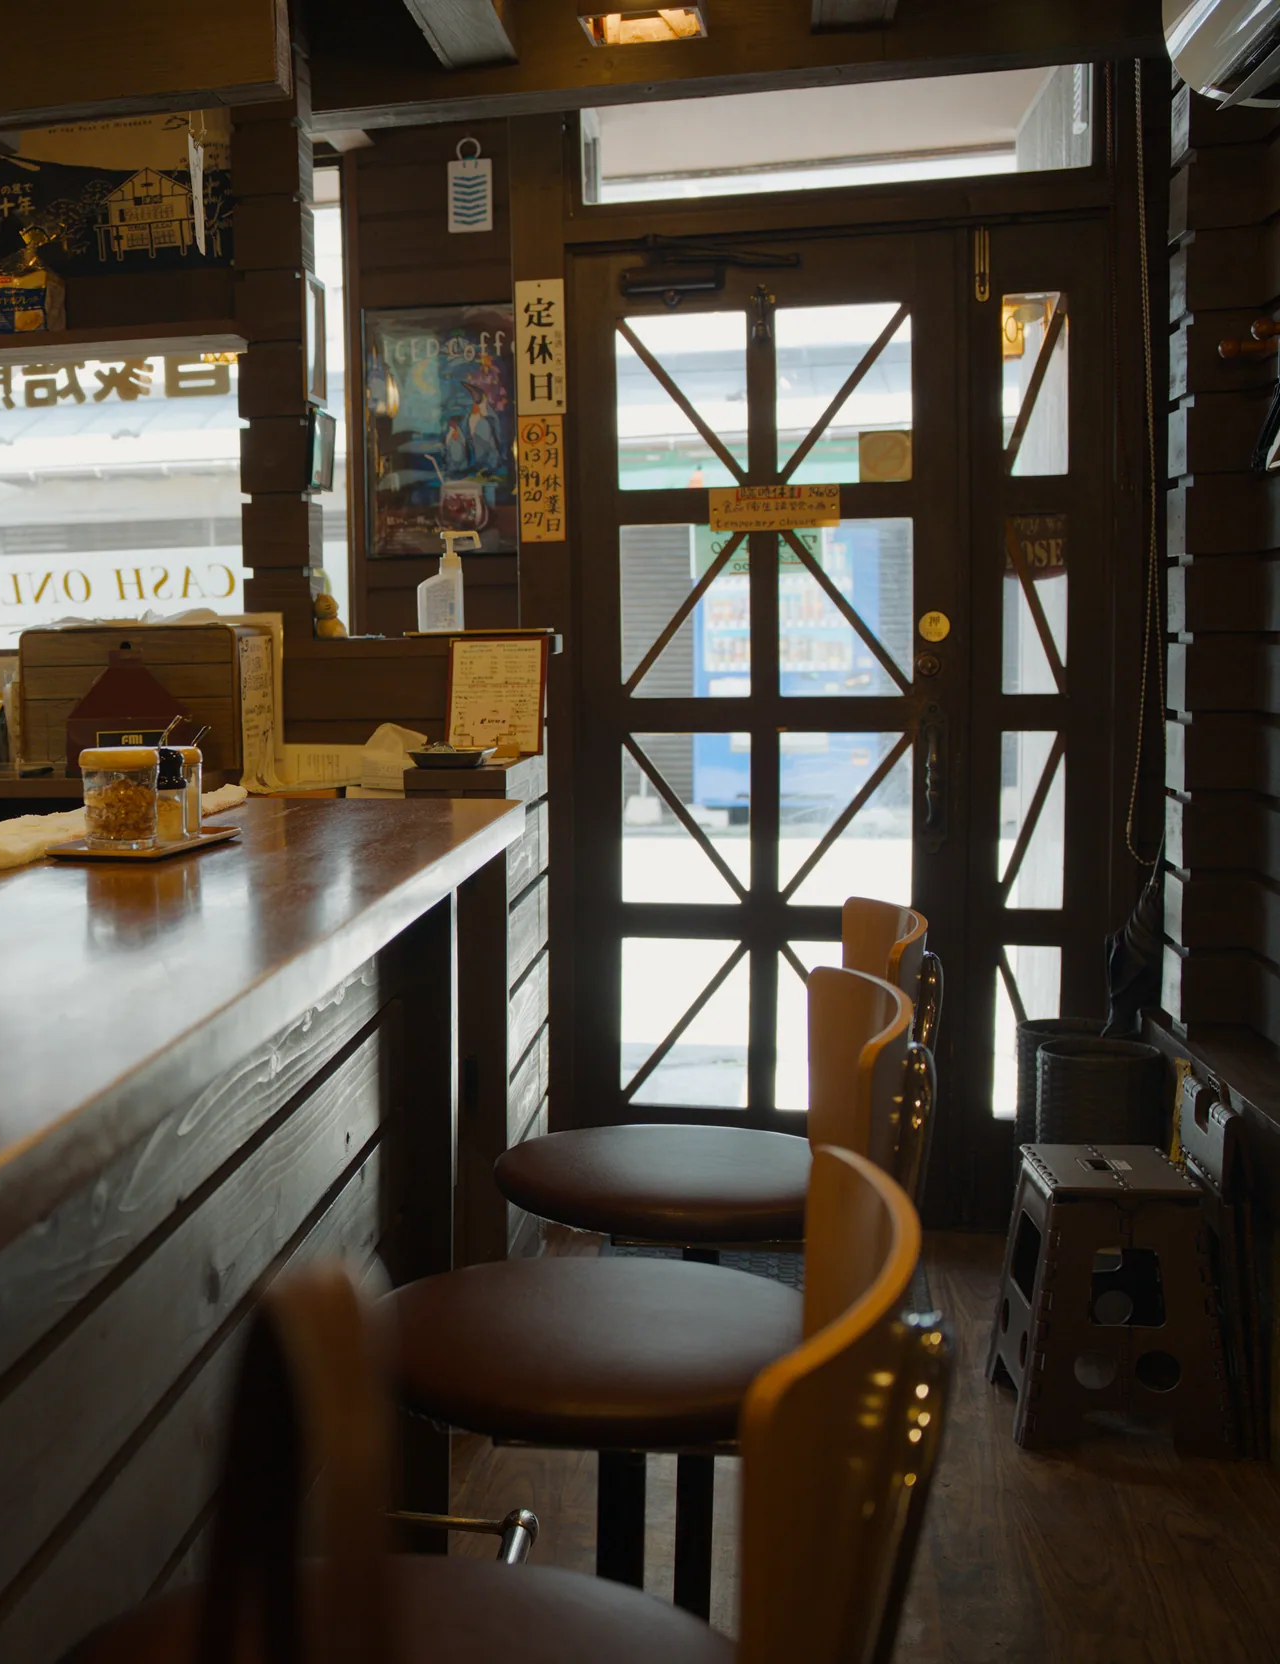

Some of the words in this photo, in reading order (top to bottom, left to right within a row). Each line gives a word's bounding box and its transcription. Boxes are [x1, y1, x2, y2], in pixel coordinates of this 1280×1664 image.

[383, 338, 440, 363] ICED
[524, 297, 556, 402] 定休日
[524, 448, 541, 462] 13
[542, 423, 562, 532] 5月休業日
[523, 490, 542, 502] 20
[523, 512, 544, 528] 27
[715, 519, 776, 529] temporary
[779, 517, 818, 527] closure
